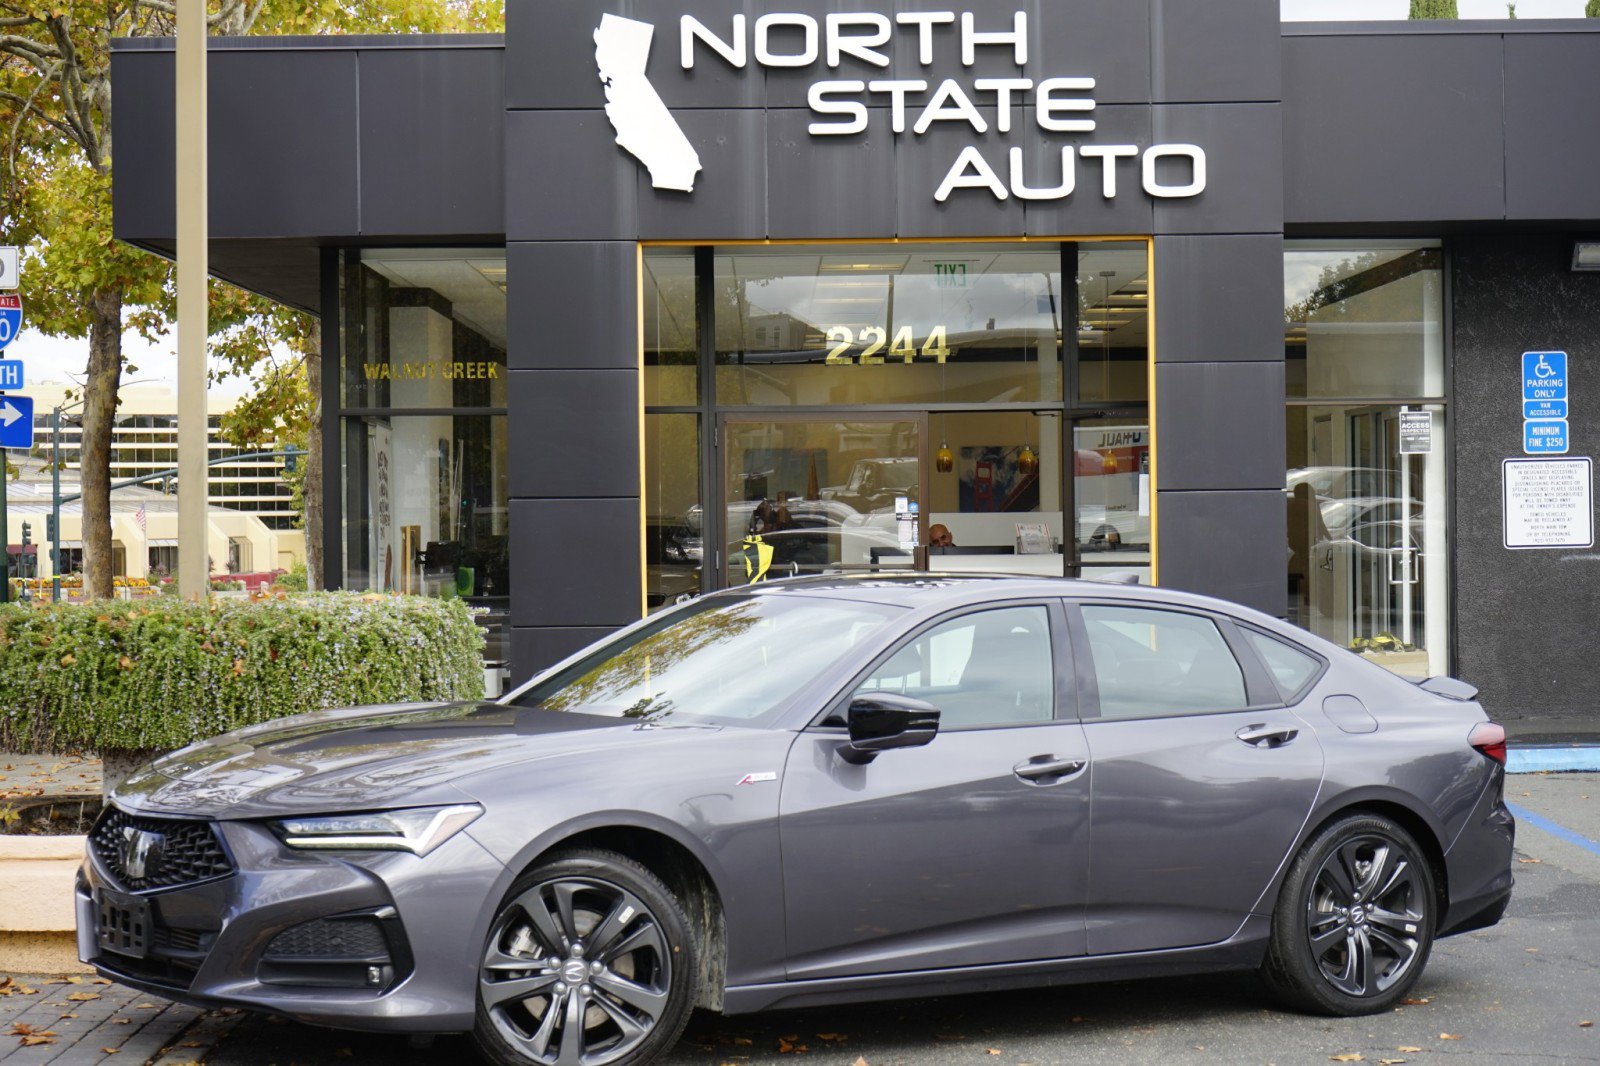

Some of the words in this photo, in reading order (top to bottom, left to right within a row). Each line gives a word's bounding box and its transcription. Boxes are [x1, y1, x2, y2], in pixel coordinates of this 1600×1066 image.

[679, 11, 1028, 69] NORTH
[807, 77, 1097, 136] STATE
[933, 144, 1208, 202] AUTO
[825, 325, 951, 365] 2244
[363, 361, 438, 380] WALNUT
[442, 361, 499, 379] CREEK
[1526, 379, 1563, 388] PARKING
[1534, 389, 1556, 398] ONLY
[1532, 426, 1560, 436] MINIMUM
[1528, 438, 1543, 447] FINE
[1546, 437, 1564, 447] $250
